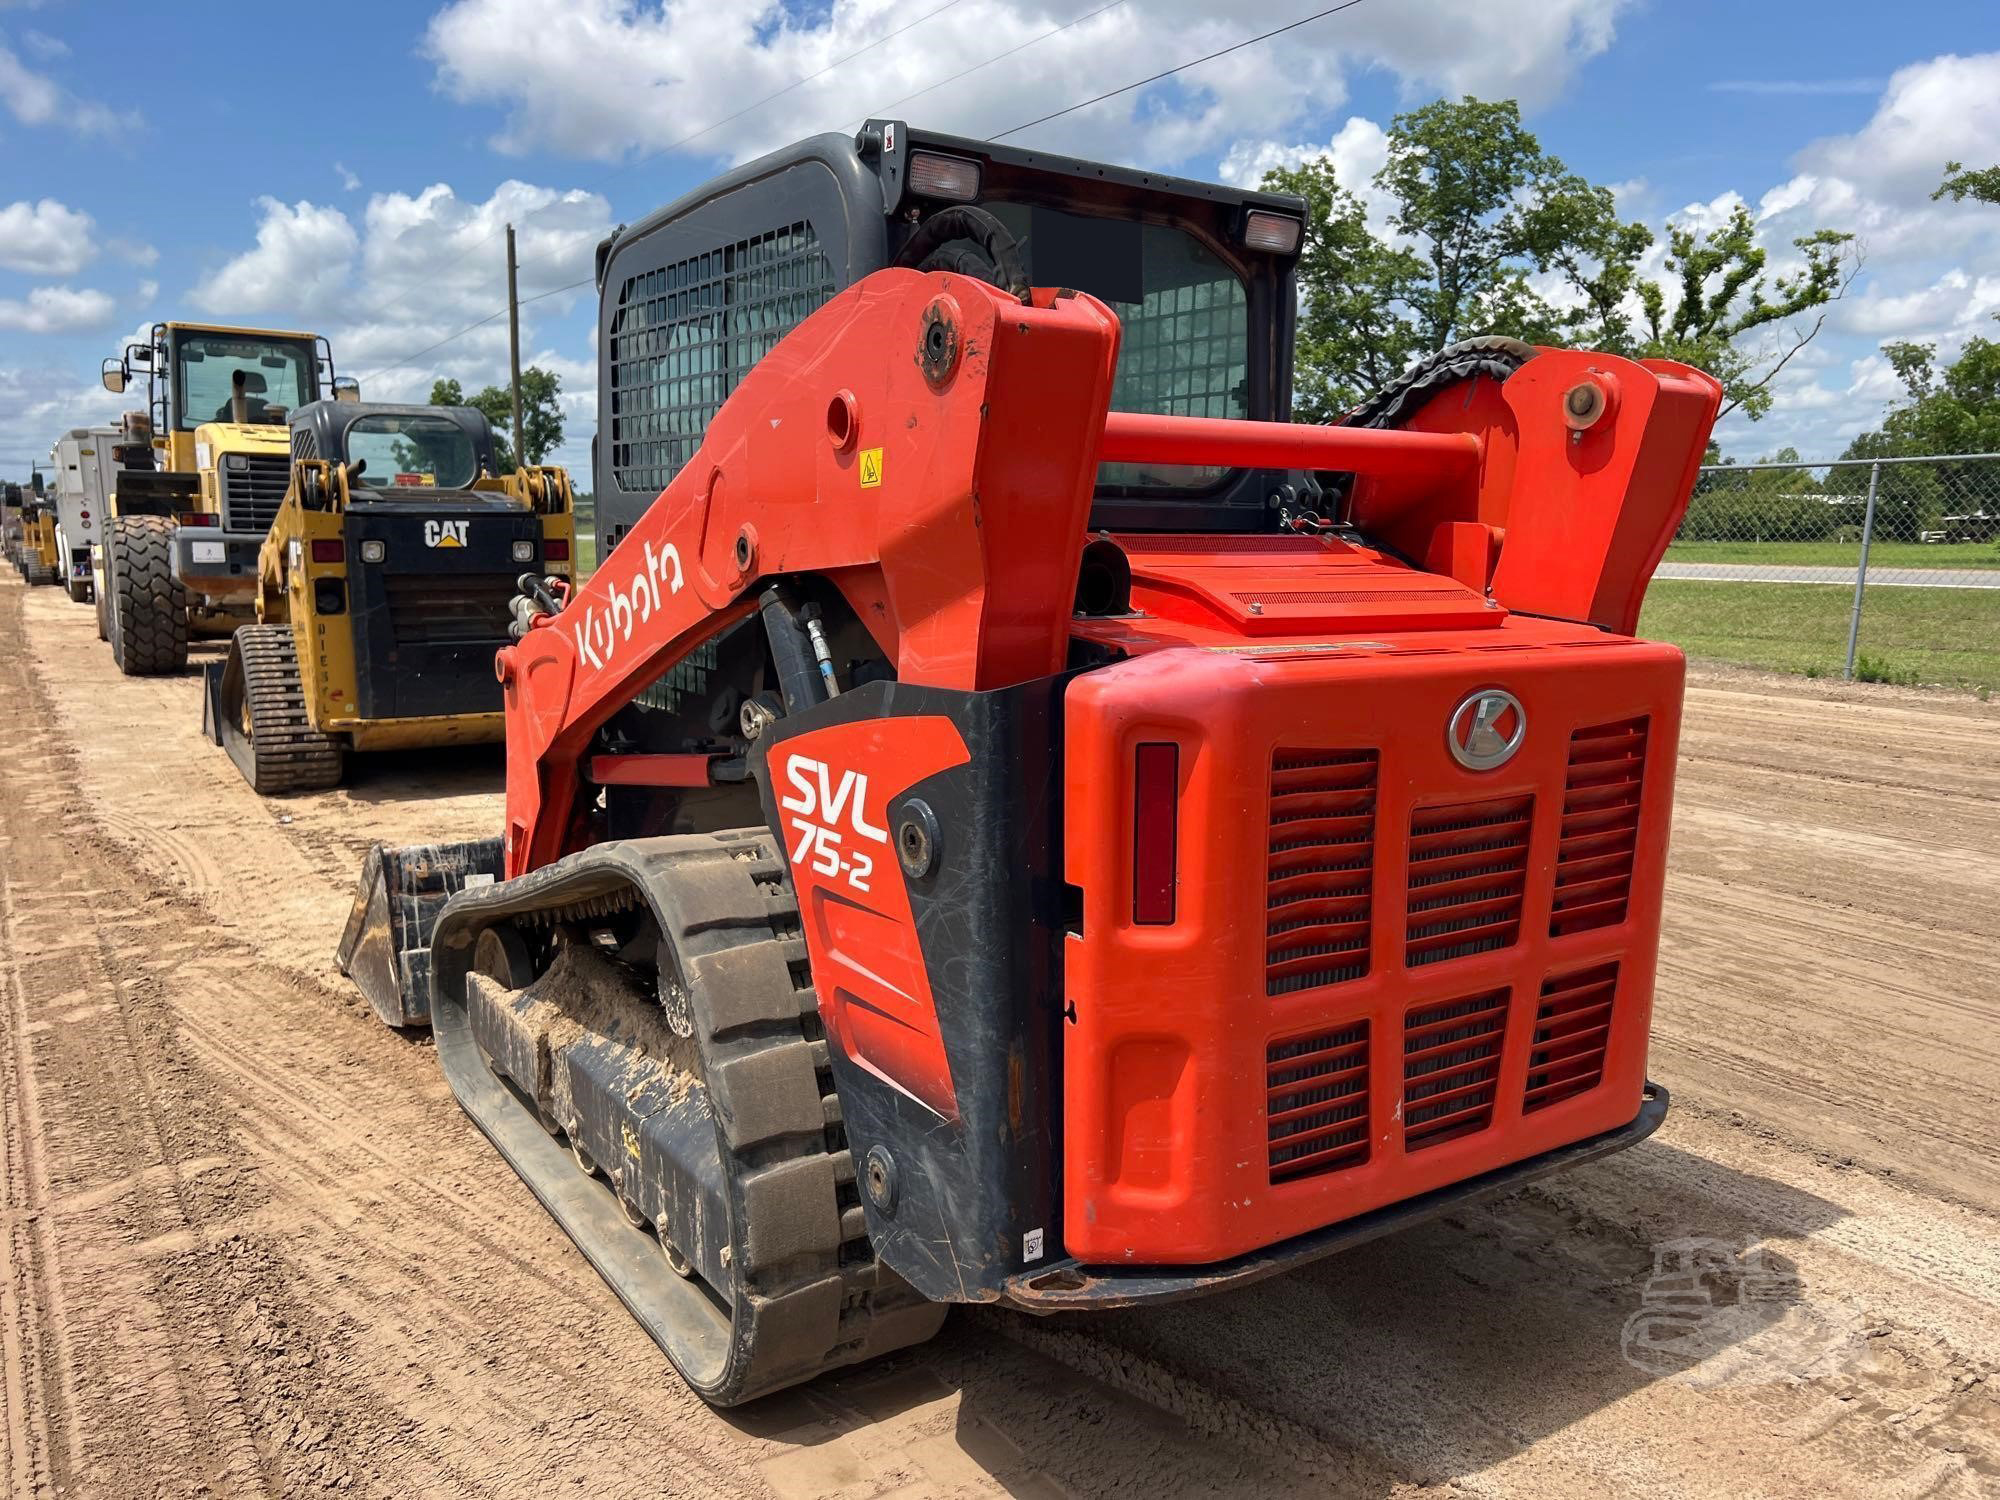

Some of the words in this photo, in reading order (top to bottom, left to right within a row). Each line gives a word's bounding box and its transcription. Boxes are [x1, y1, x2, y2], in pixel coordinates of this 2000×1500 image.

[424, 519, 470, 548] CAT
[574, 542, 685, 671] Kubota
[782, 754, 888, 843] SVL
[791, 818, 873, 892] 75-2
